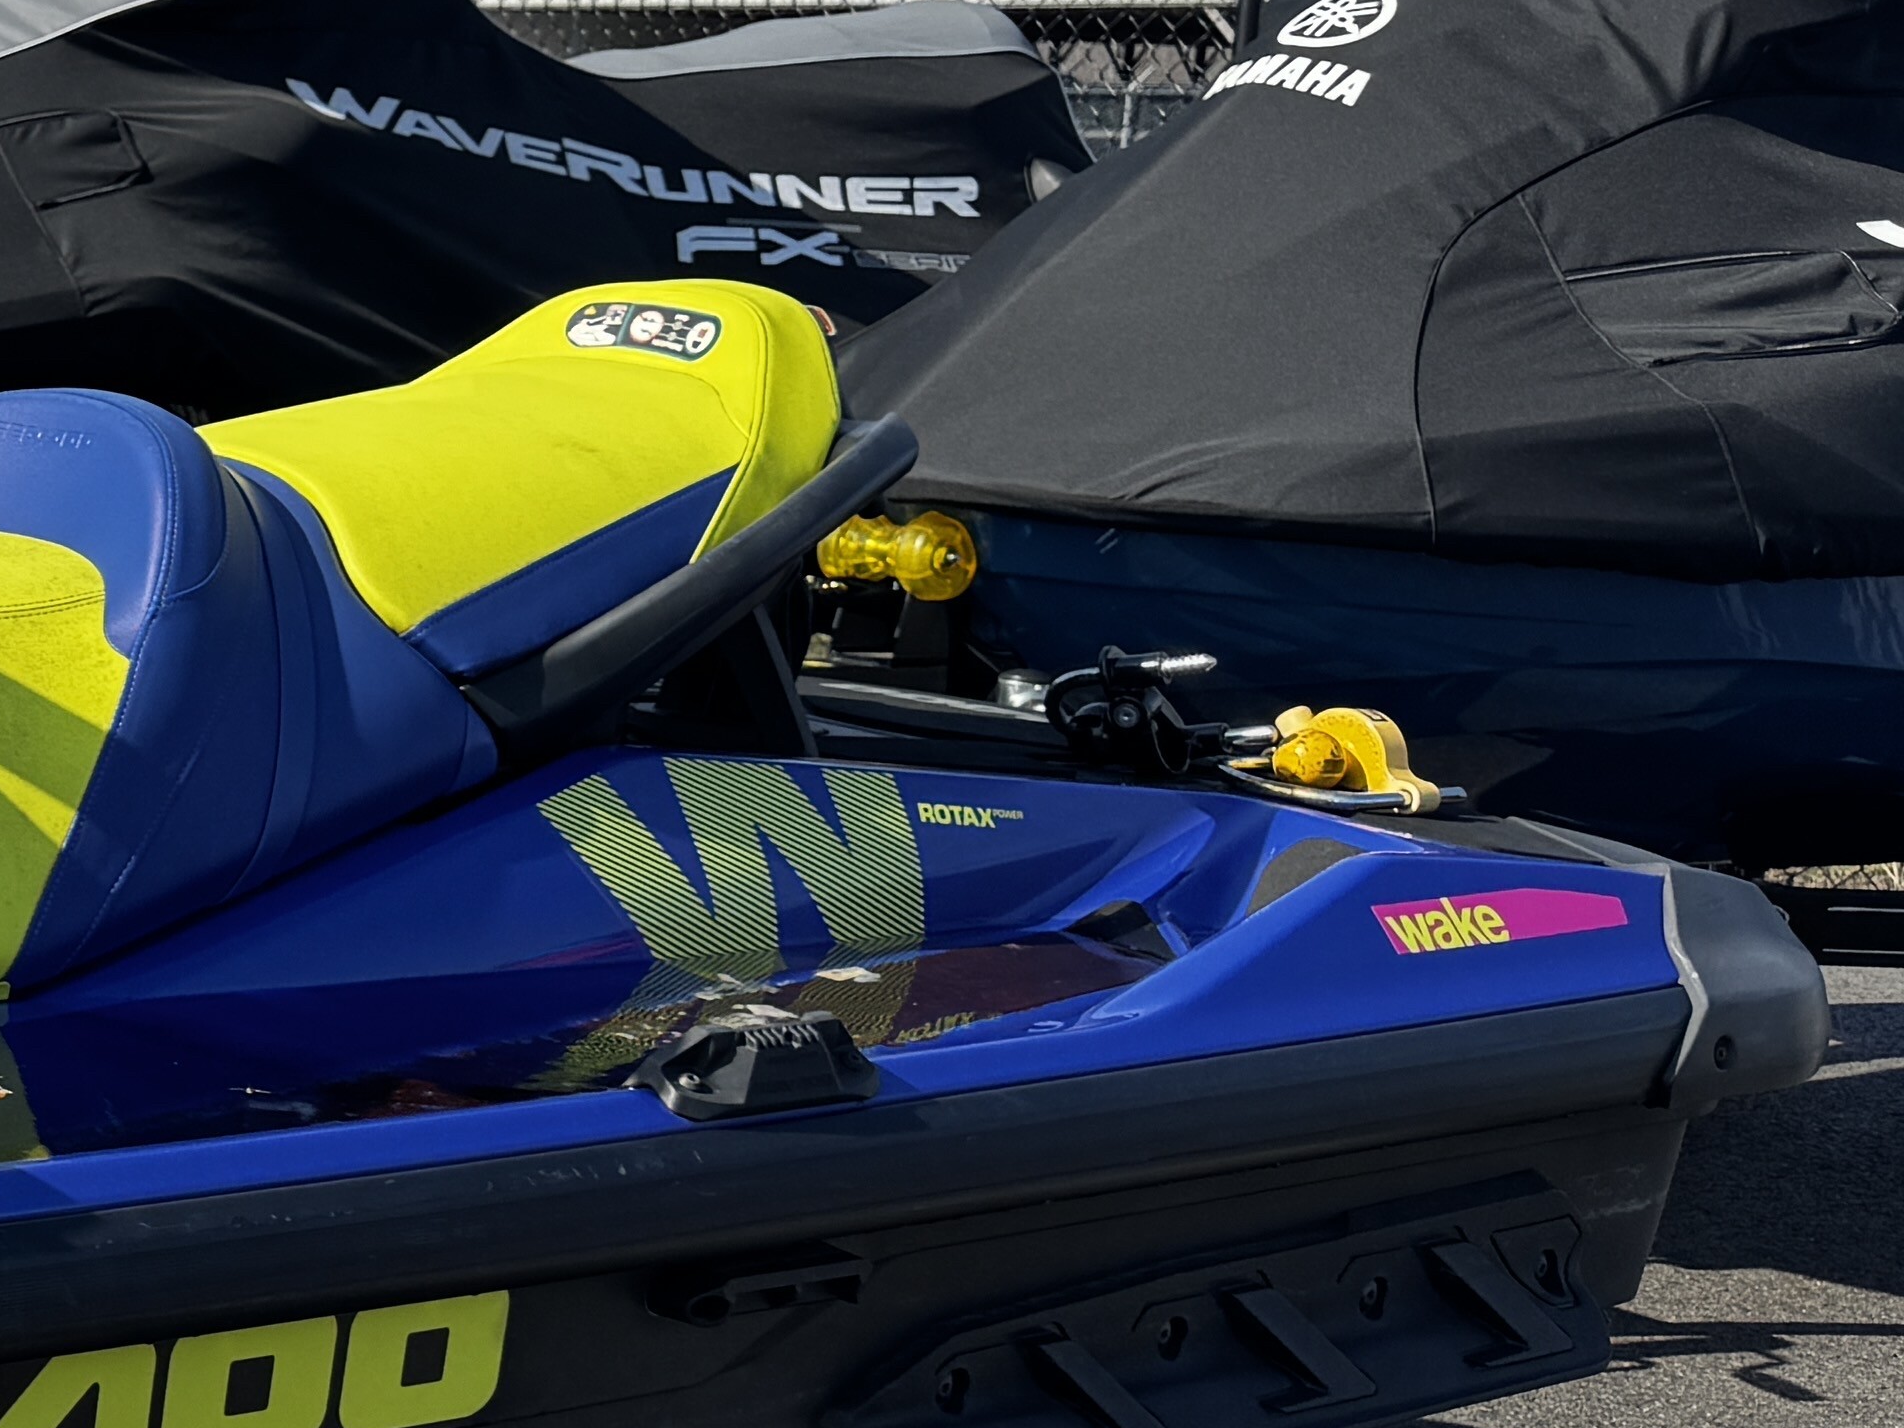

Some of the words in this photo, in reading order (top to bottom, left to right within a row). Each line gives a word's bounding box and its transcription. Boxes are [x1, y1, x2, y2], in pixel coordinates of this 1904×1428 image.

[285, 77, 981, 218] WAVERUNNER
[676, 224, 844, 267] FX
[917, 802, 996, 829] ROTAX
[1385, 897, 1511, 954] wake
